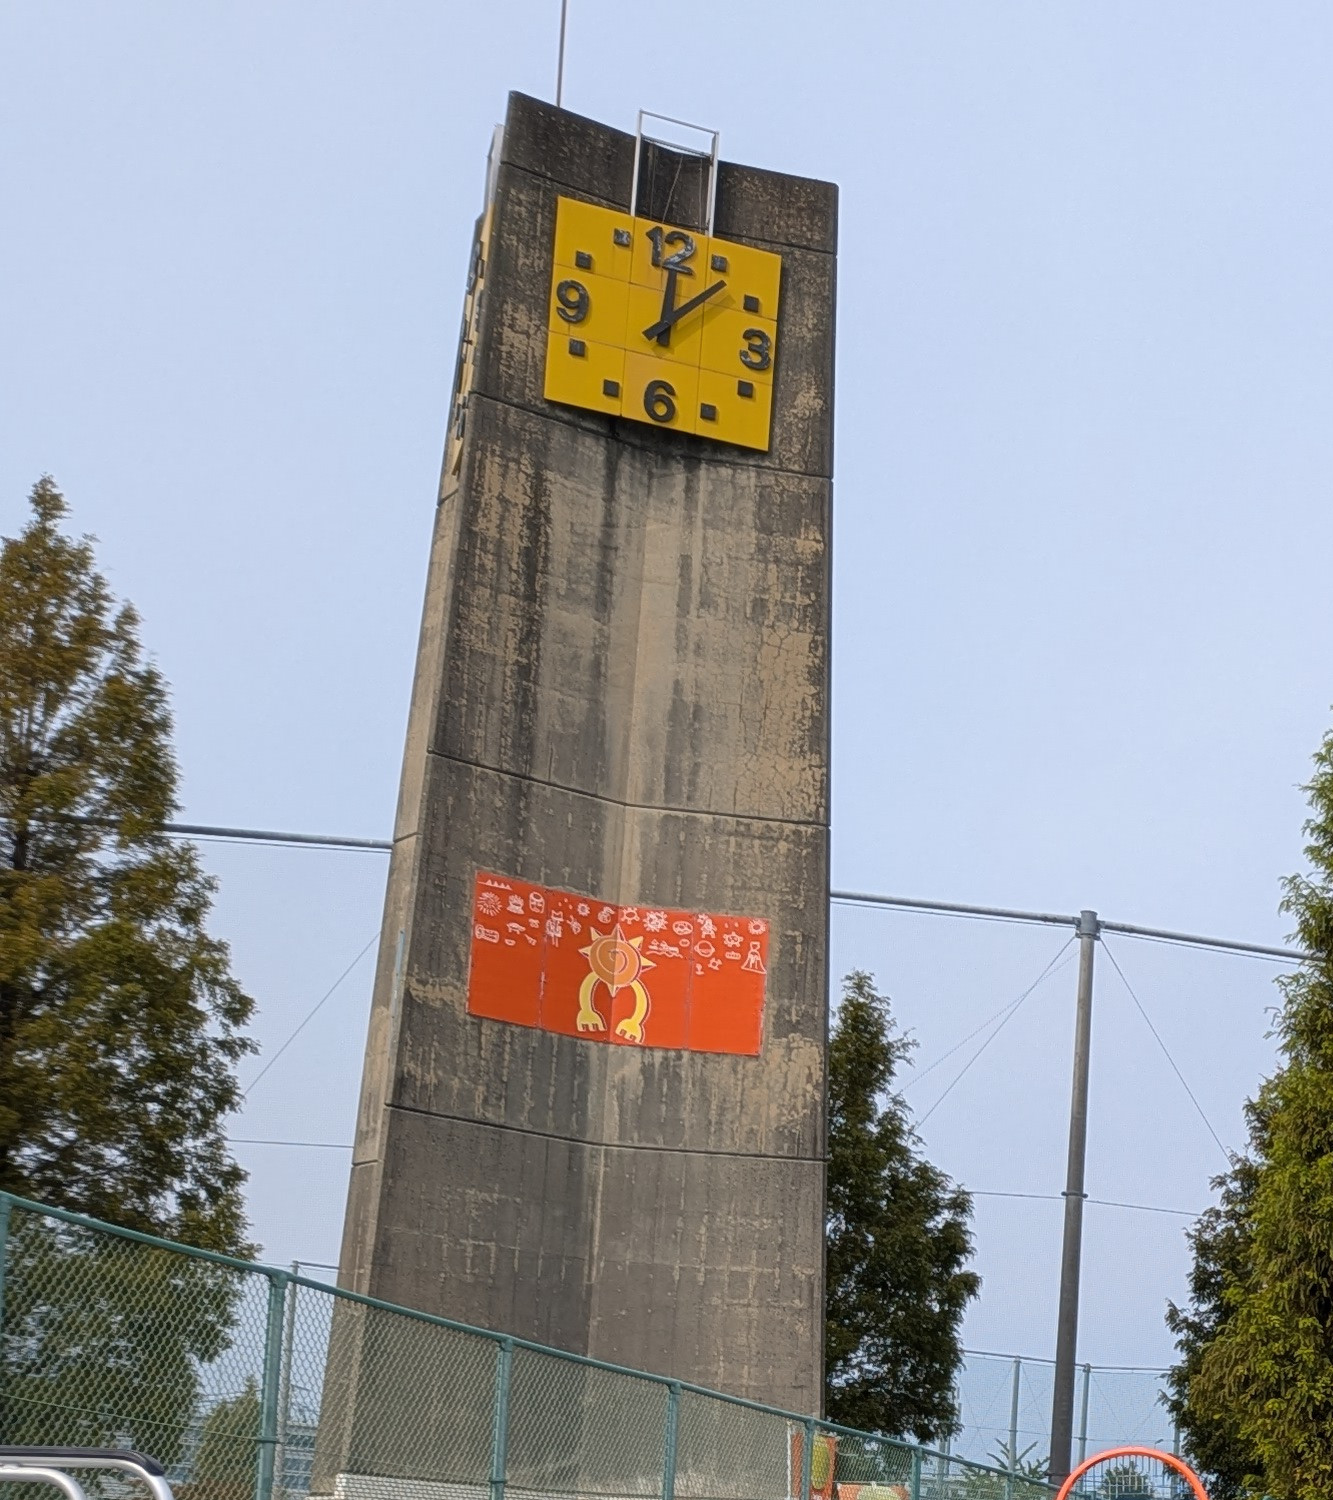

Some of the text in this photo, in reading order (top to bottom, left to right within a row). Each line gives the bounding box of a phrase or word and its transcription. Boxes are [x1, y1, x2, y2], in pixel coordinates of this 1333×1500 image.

[646, 226, 696, 277] 12
[556, 279, 590, 324] 9
[739, 328, 772, 371] 3
[643, 379, 677, 423] 6
